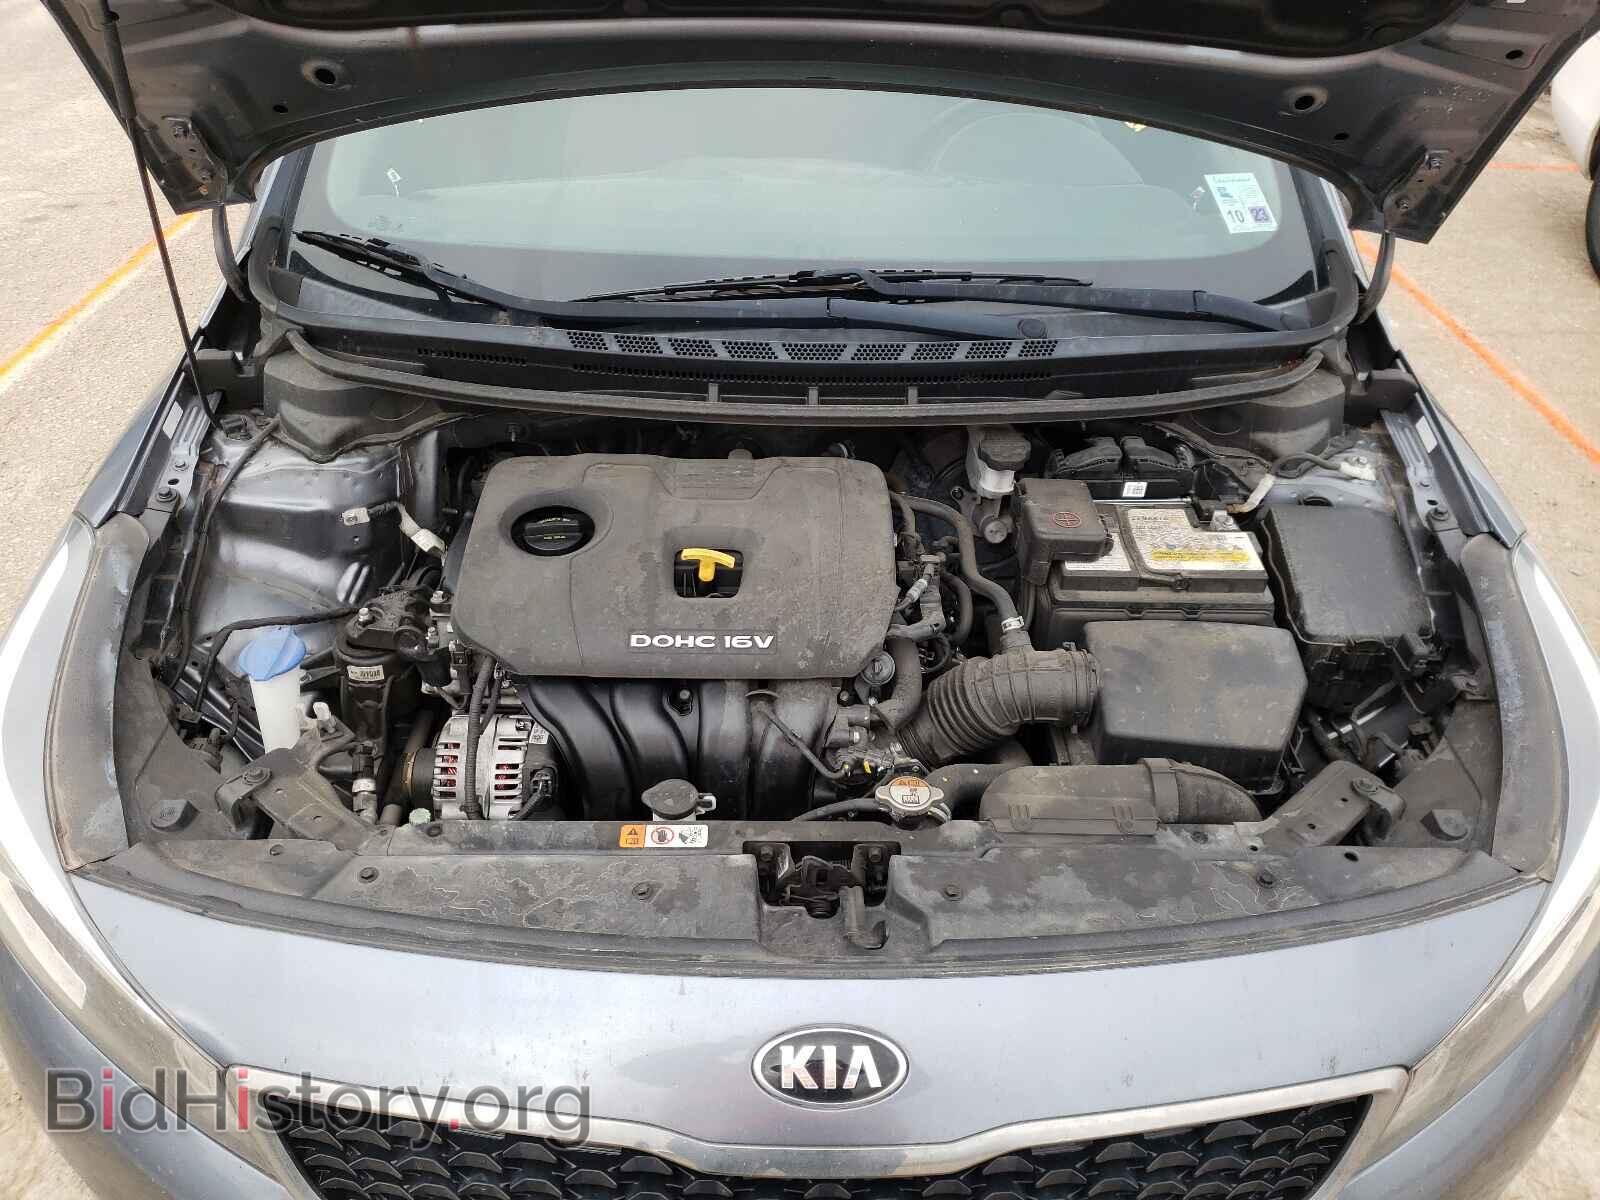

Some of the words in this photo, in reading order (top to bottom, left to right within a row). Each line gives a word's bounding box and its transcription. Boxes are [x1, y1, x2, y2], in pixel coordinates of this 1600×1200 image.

[1227, 209, 1244, 223] 10
[630, 634, 716, 648] DOHC
[723, 635, 774, 648] 16V
[779, 1045, 882, 1089] KIA
